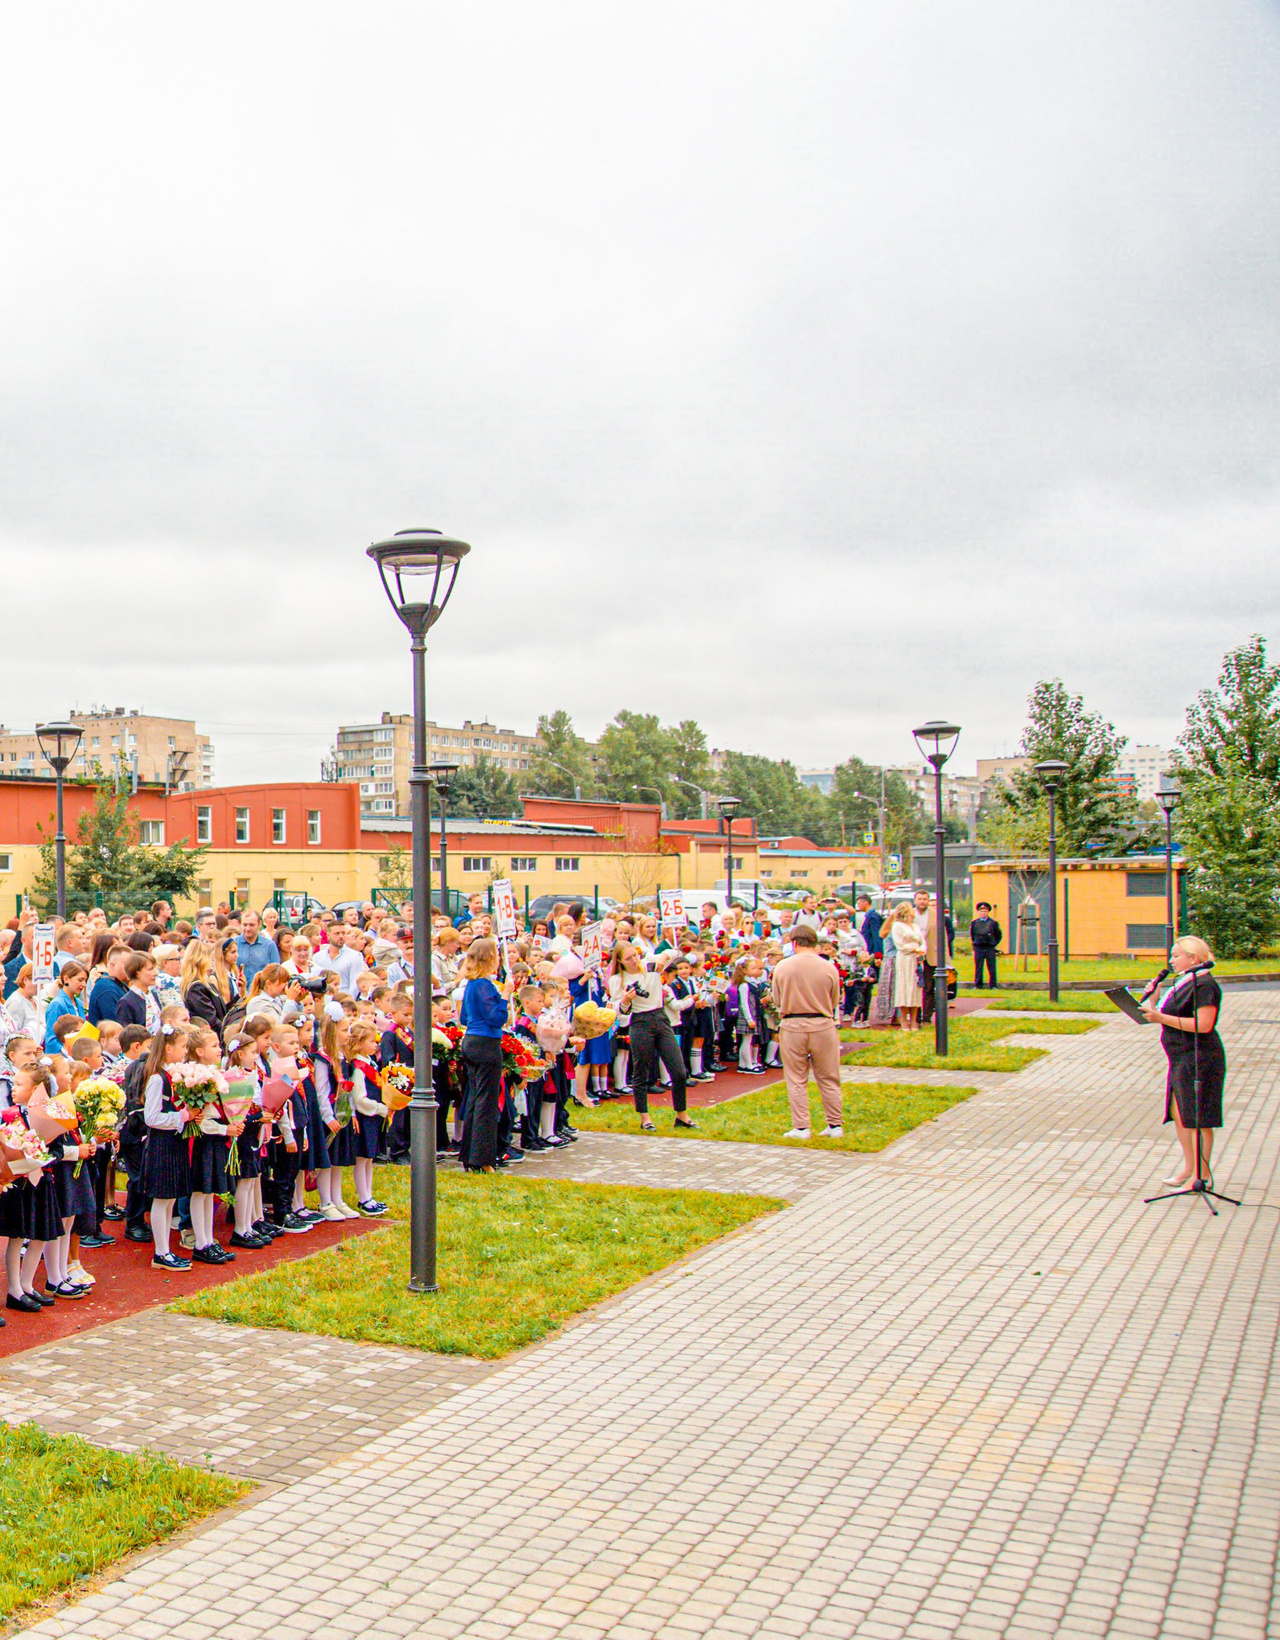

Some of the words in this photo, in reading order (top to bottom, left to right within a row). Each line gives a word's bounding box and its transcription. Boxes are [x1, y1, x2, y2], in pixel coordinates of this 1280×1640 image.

[497, 895, 512, 919] 1-В
[662, 899, 683, 916] 2-Б
[35, 941, 52, 966] 1-Б
[583, 935, 600, 958] 2-А
